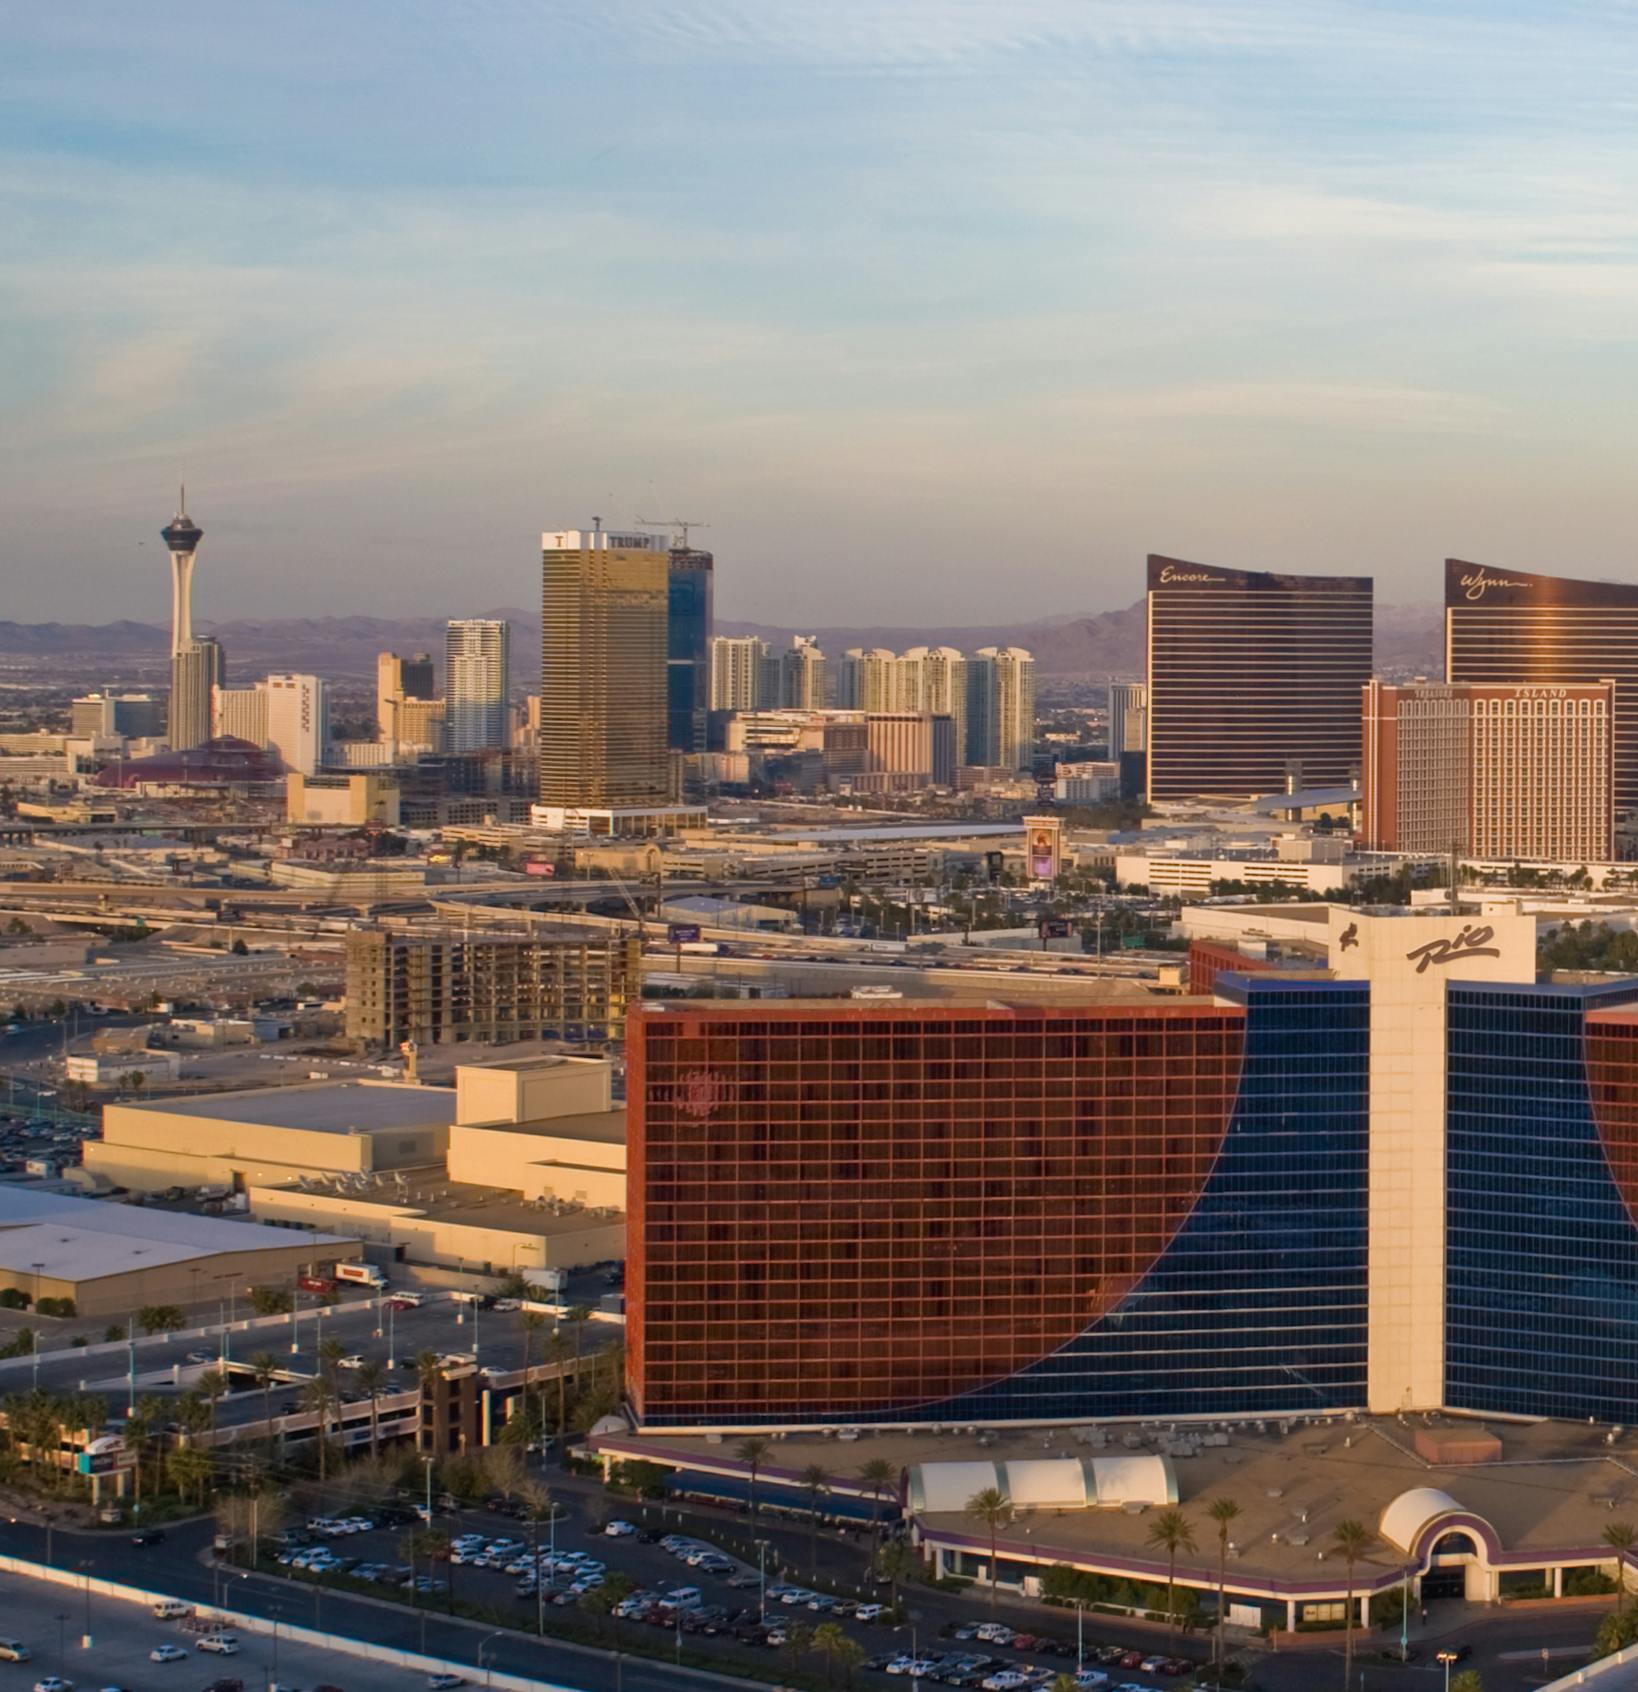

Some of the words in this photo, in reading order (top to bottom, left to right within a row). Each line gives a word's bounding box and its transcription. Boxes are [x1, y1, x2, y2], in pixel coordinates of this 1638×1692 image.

[609, 536, 650, 549] TRUMP
[1160, 565, 1227, 584] Encore
[1460, 567, 1533, 601] Wynn
[1414, 689, 1454, 699] TREASURE
[1514, 688, 1567, 699] ISLAND
[1405, 924, 1501, 974] Rio
